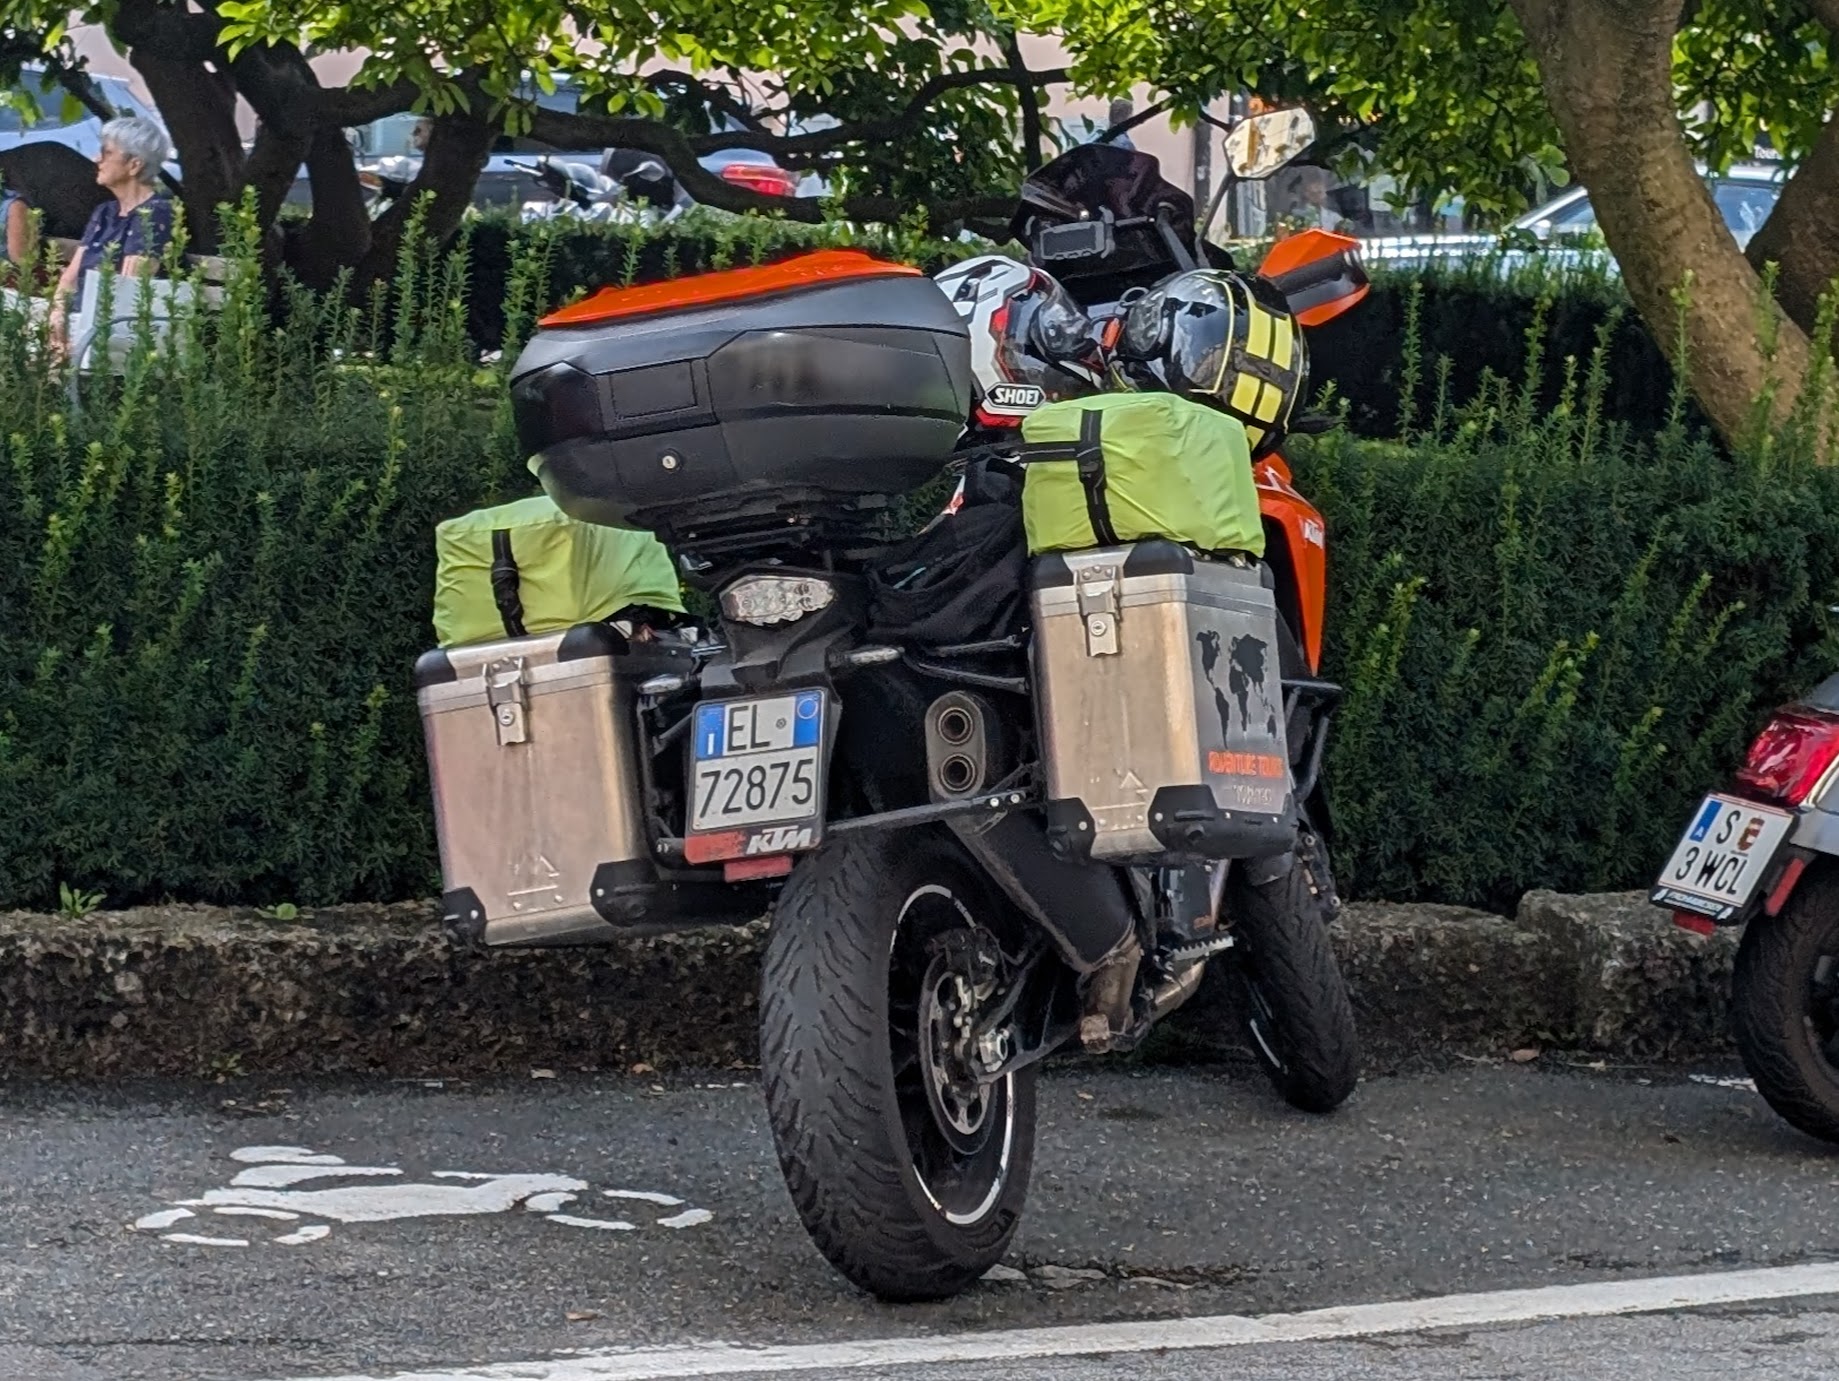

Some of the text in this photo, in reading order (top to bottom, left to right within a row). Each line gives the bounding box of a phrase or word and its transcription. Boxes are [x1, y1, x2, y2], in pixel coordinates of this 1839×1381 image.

[994, 387, 1040, 405] SHOEI
[707, 733, 715, 755] I
[727, 704, 770, 751] EL
[700, 758, 814, 819] 72875
[746, 825, 813, 854] KTM
[1716, 810, 1741, 844] S
[1675, 847, 1748, 895] 3 WCL
